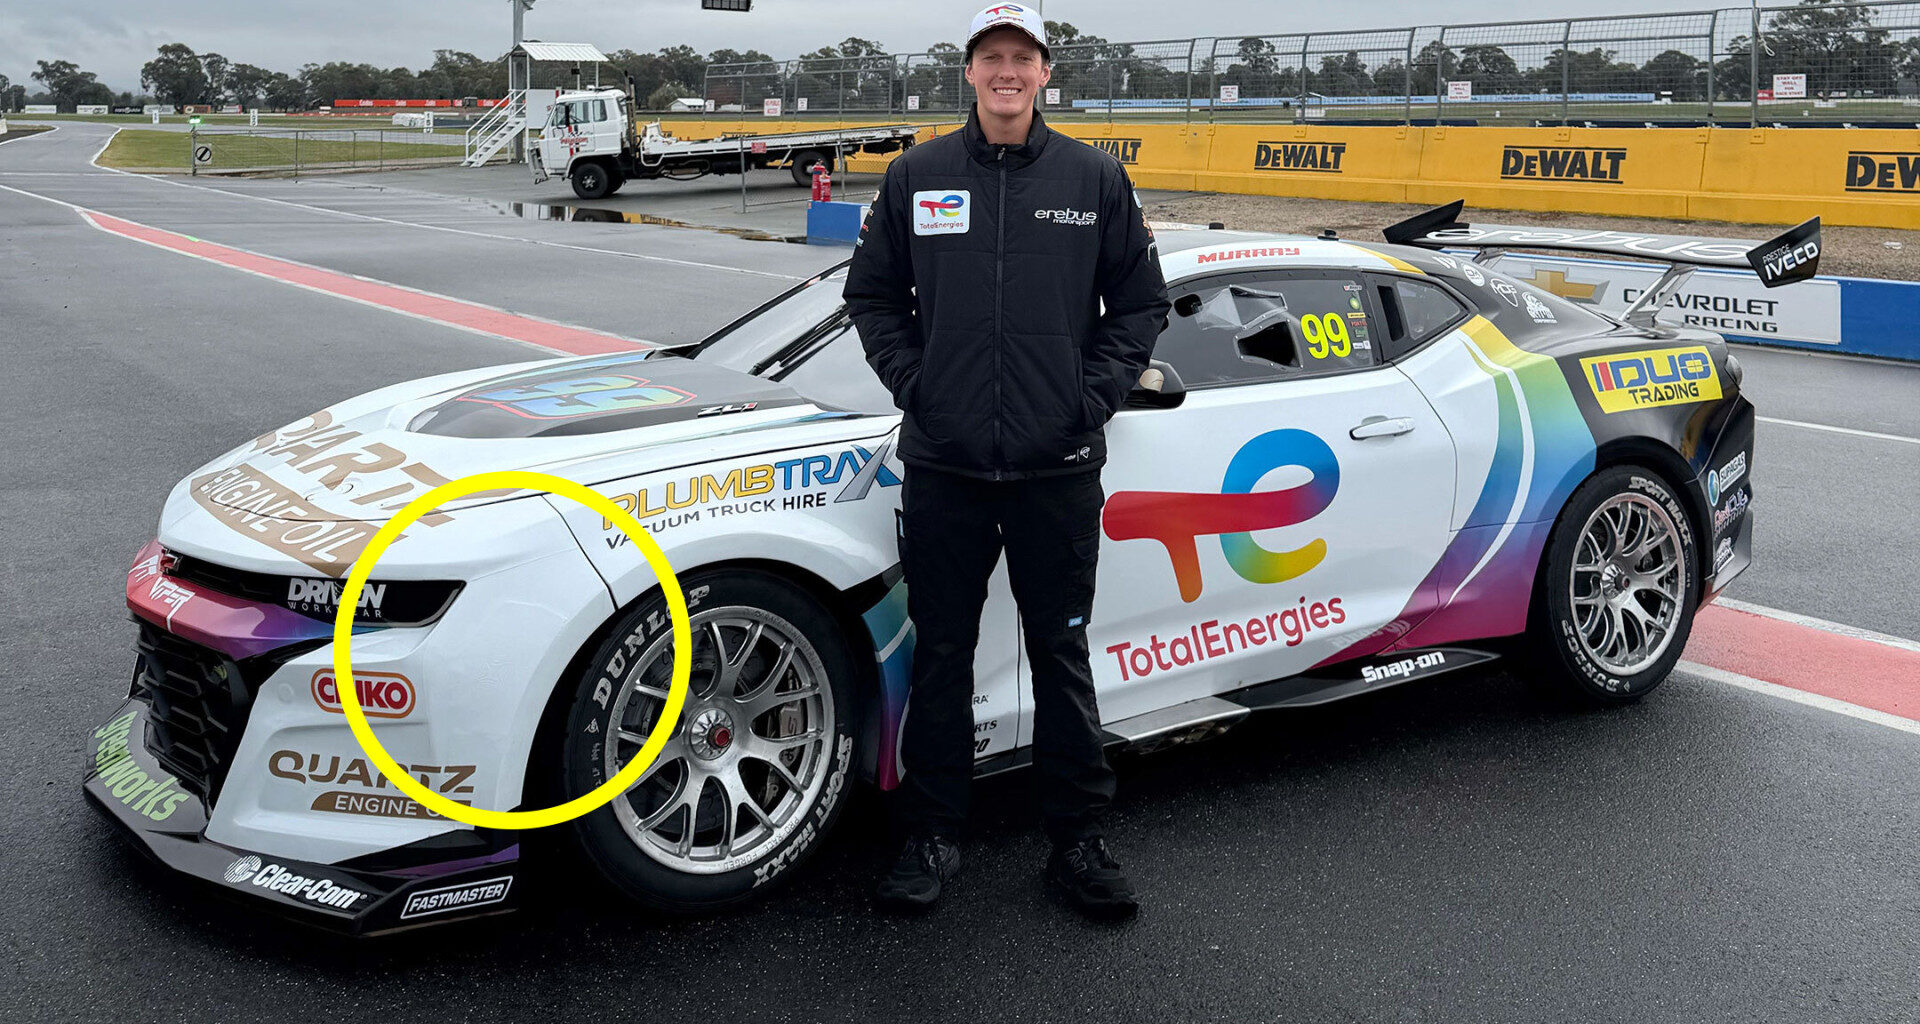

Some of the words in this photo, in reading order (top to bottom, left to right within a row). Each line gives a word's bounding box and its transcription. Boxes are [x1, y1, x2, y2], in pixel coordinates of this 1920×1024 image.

[1034, 207, 1097, 221] erebus
[1053, 218, 1096, 226] motorsport
[1197, 247, 1301, 264] MURRAY
[1762, 243, 1791, 265] PRESTIGE
[1764, 241, 1819, 281] IVECO
[1300, 312, 1351, 359] 99
[1684, 315, 1779, 334] RACING
[1628, 381, 1700, 405] TRADING
[603, 434, 902, 531] PLUMBTRAX
[200, 466, 308, 534] ENGINE
[280, 520, 366, 563] OIL
[710, 499, 776, 520] TRUCK
[782, 492, 827, 512] HIRE
[1628, 476, 1670, 502] SPORT
[1665, 498, 1693, 547] MAXX
[287, 601, 383, 618] WORKAR
[592, 584, 711, 711] DUNLP
[1105, 595, 1347, 683] TotalEnergies
[1361, 651, 1446, 684] Snap-on
[334, 794, 418, 817] ENGINE
[409, 883, 505, 913] FASTMASTER
